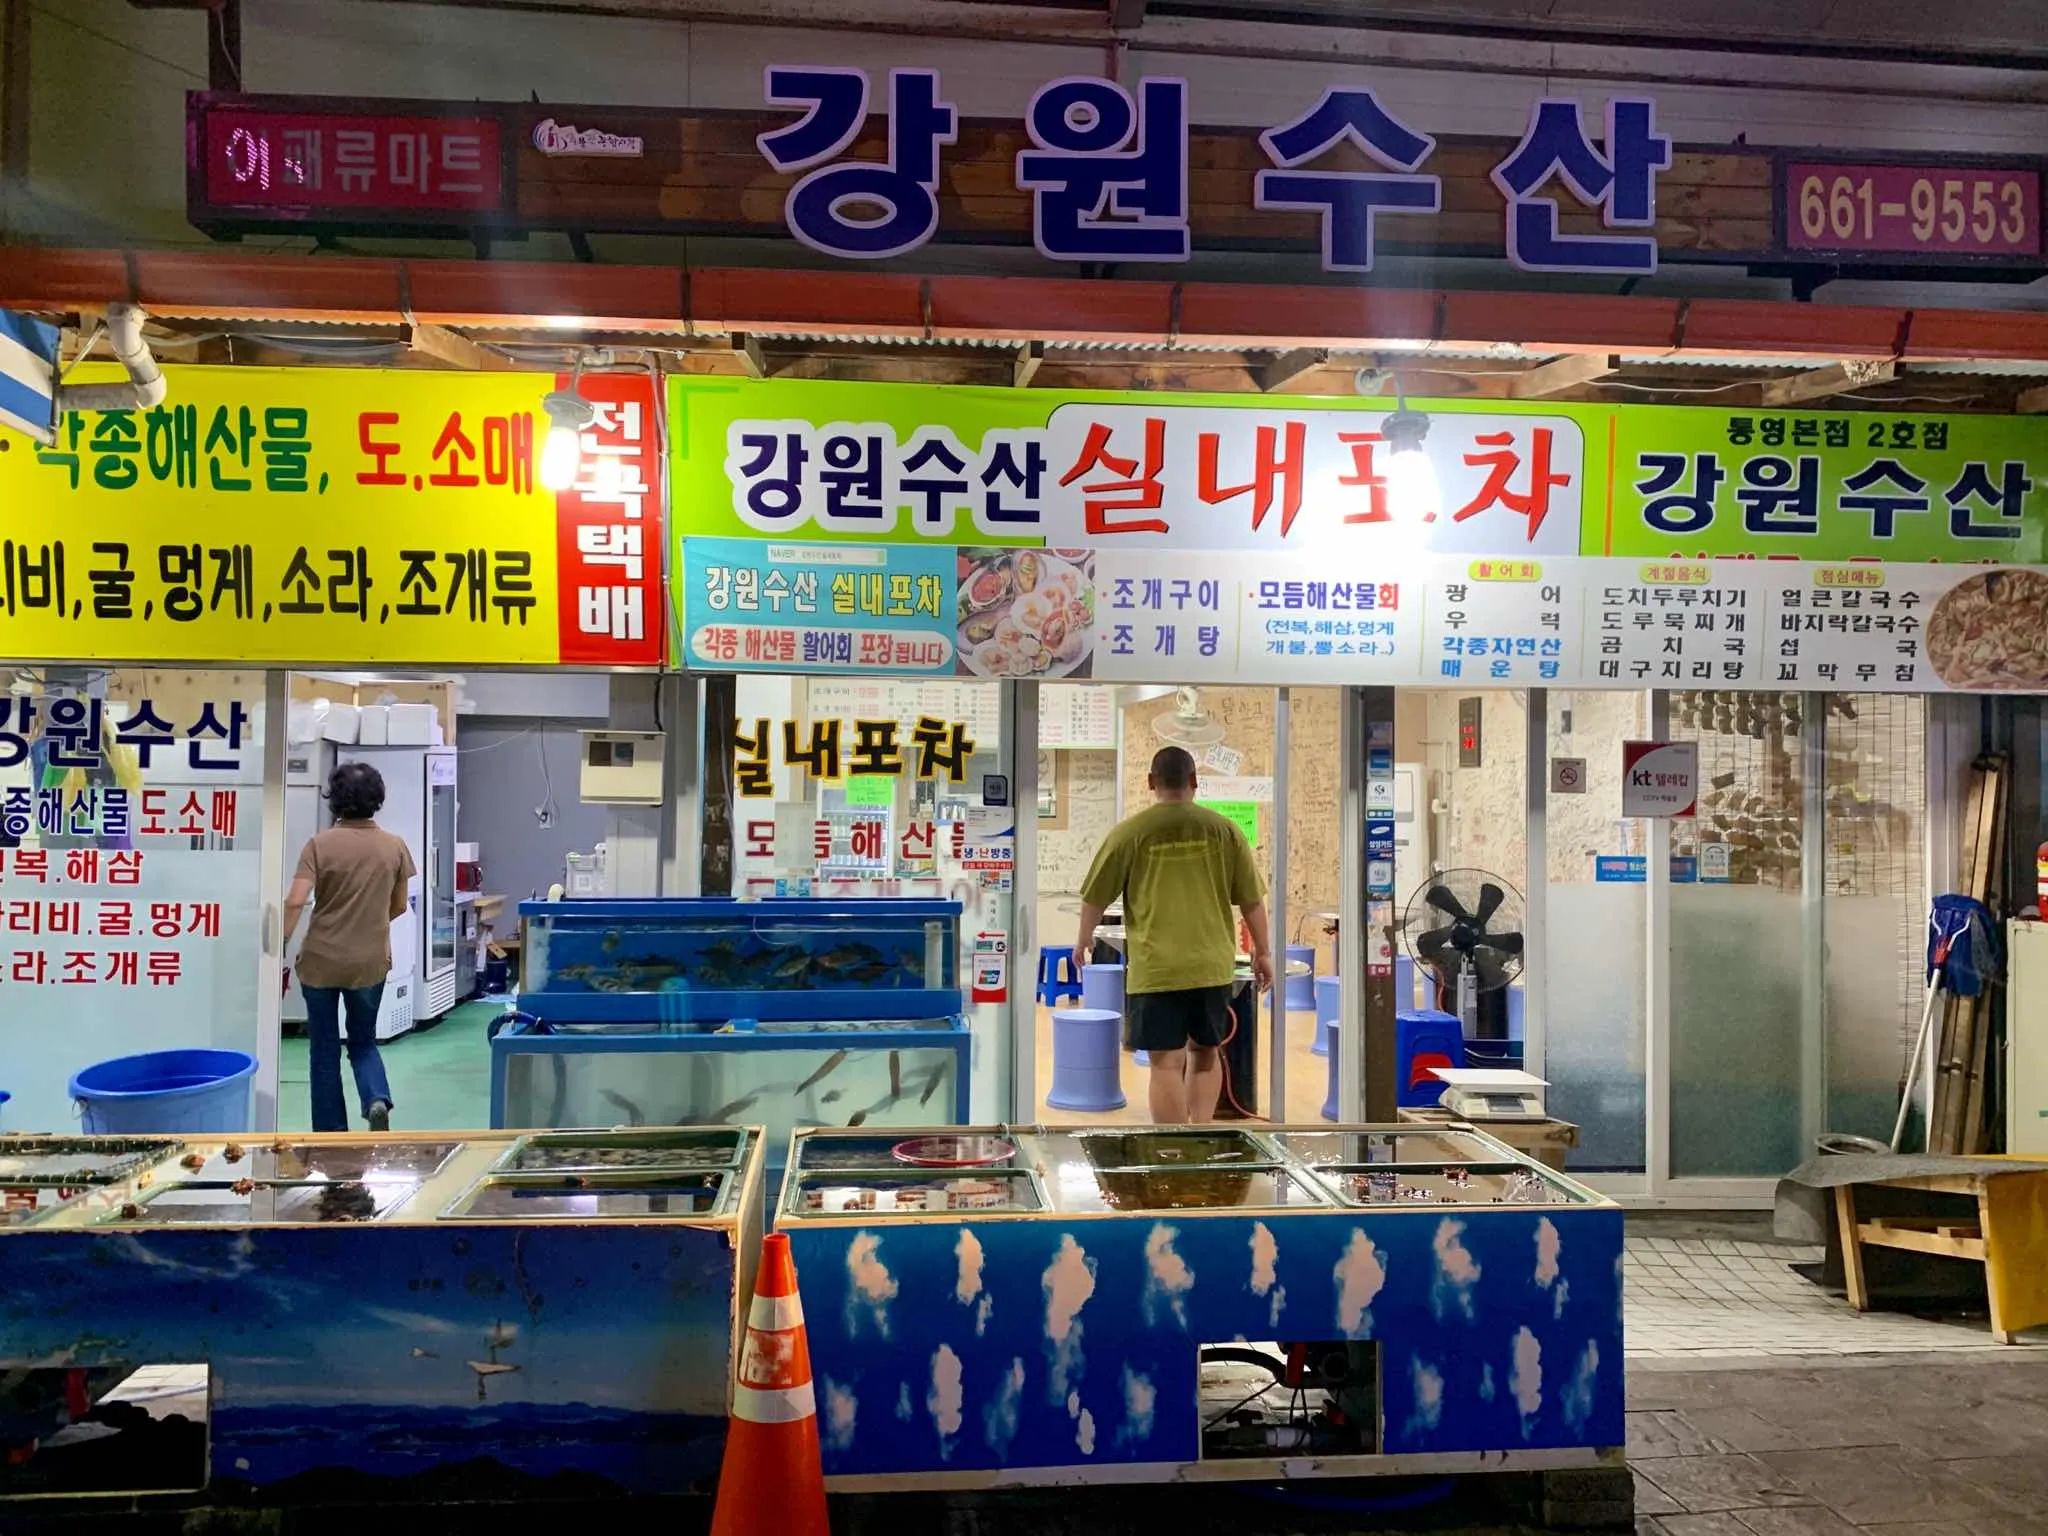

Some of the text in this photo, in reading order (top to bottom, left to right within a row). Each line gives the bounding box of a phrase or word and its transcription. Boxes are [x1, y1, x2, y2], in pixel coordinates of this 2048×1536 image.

[756, 65, 1673, 274] 강원수산
[1799, 174, 2027, 244] 661-9553
[1727, 417, 1949, 450] 통영본점 2호점
[739, 433, 1047, 523] 강원수산
[1634, 452, 2034, 540] 강원수산
[574, 401, 649, 640] 전국택배
[1648, 565, 1707, 581] 계절음식
[1821, 568, 1881, 584] 점심메뉴
[705, 566, 944, 618] 강원수산 실내포차
[1112, 578, 1220, 611] 조개구이
[1258, 581, 1400, 611] 모듬해산물회
[1601, 587, 1747, 608] 도치두루치기
[1781, 588, 1921, 610] 얼큰칼국수
[1600, 611, 1746, 633] 도루묵찌개
[1780, 613, 1921, 635] 바지락칼국수
[704, 626, 738, 661] 각종
[745, 629, 797, 662] 해산물
[803, 630, 852, 664] 활어회
[734, 716, 976, 797] 실내포차
[1633, 769, 1652, 787] kt
[0, 847, 145, 885] 복.해삼
[0, 900, 222, 938] 리비.굴.멍게
[0, 950, 182, 986] 라.조개류
